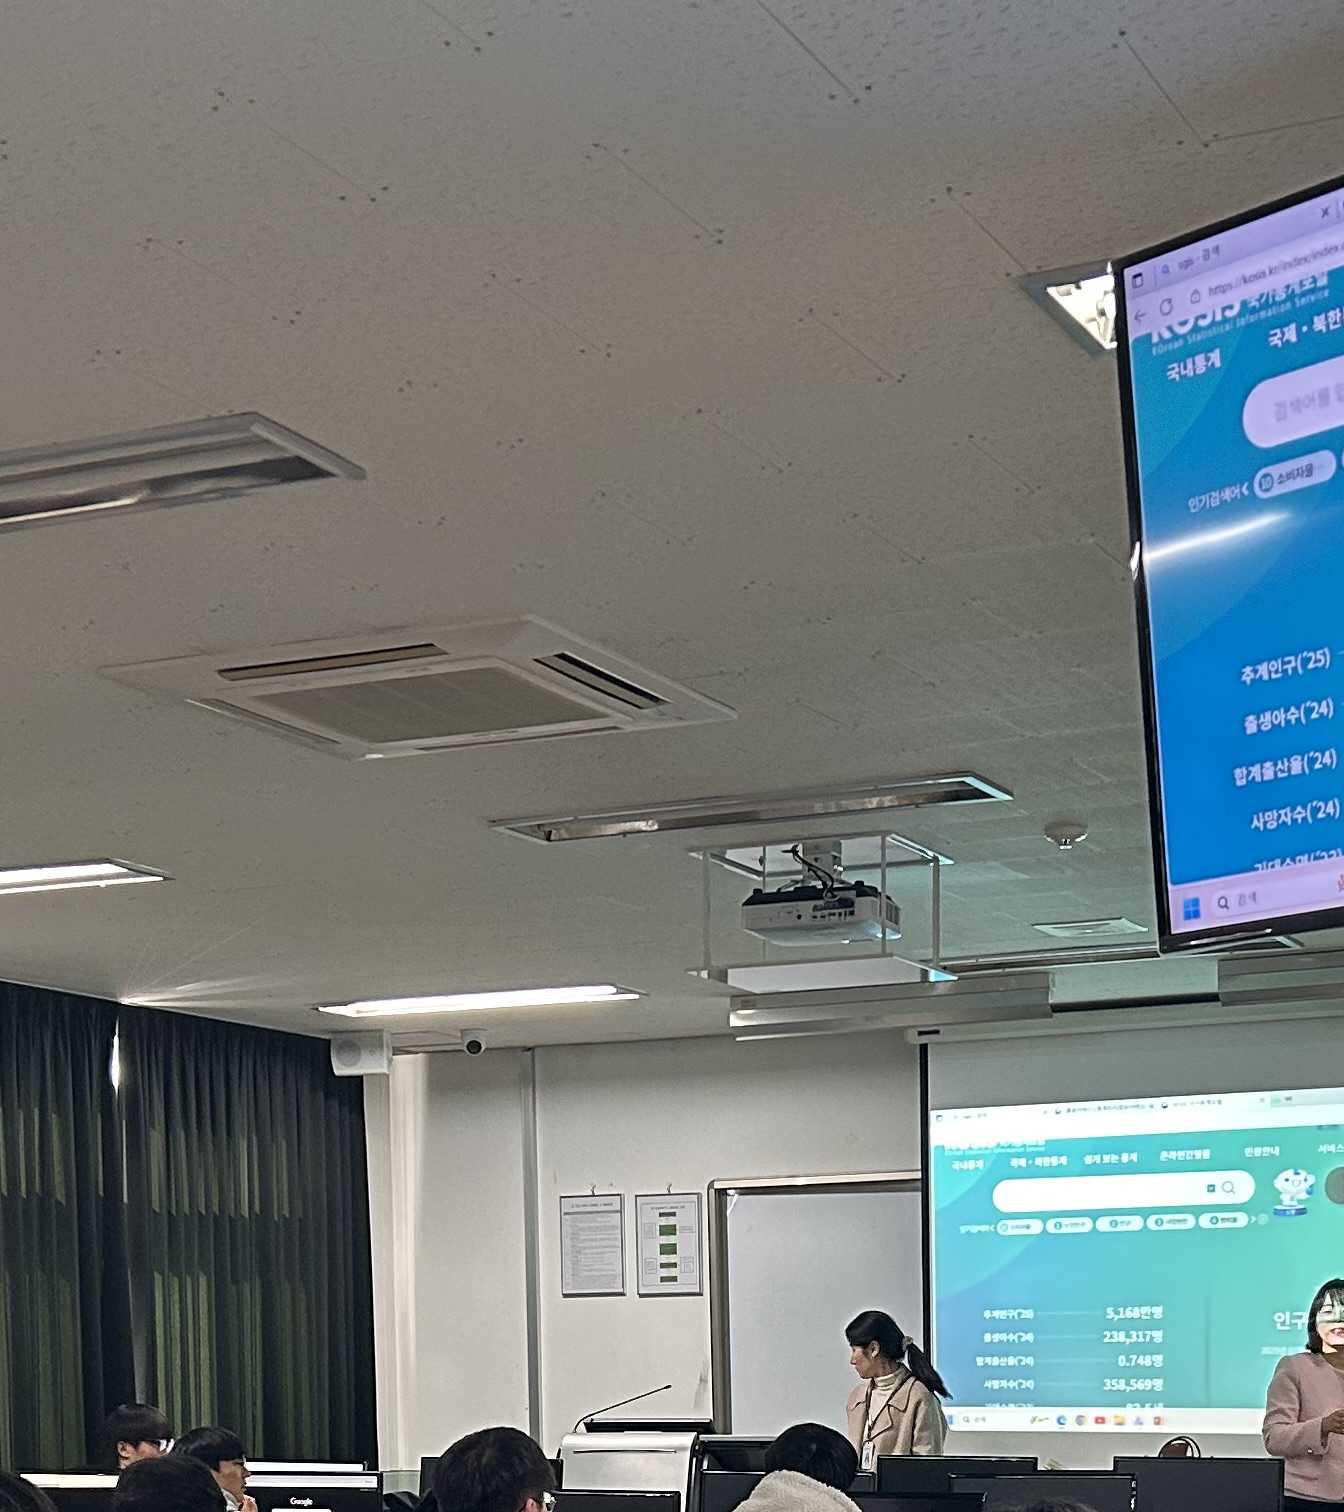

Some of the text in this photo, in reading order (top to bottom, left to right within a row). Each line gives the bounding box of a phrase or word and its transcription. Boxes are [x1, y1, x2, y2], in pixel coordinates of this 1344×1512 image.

[1267, 323, 1298, 349] 국제
[1166, 348, 1223, 381] 국내통계
[1106, 1306, 1163, 1321] 5,168만명
[1103, 1329, 1163, 1345] 238,317명
[1118, 1353, 1163, 1368] 0.748명
[1103, 1378, 1163, 1393] 358,569명
